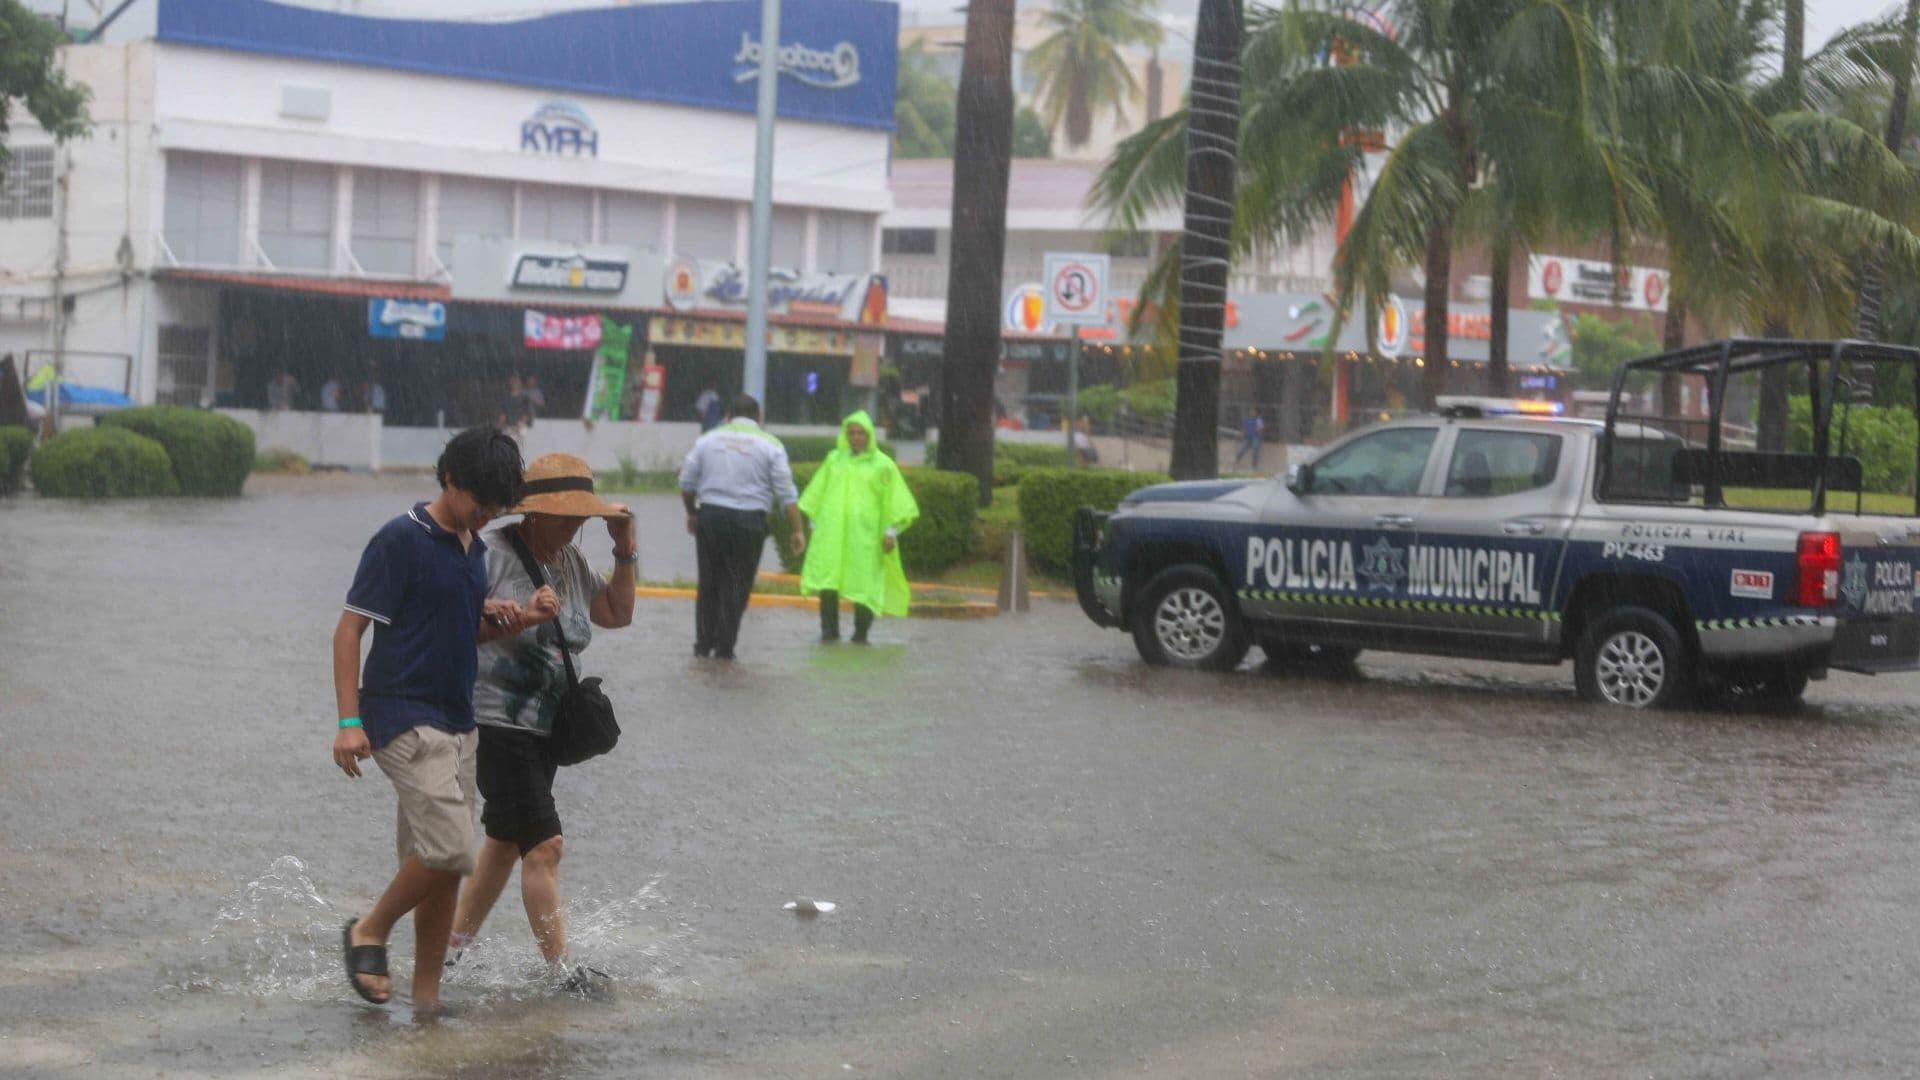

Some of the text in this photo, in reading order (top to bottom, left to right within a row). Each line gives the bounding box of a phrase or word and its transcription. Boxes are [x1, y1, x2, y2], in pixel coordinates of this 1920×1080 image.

[1622, 525, 1746, 543] POLICIA VIAL
[1602, 541, 1666, 561] PV-463
[1246, 536, 1540, 604] POLICIA MUNICIPAL
